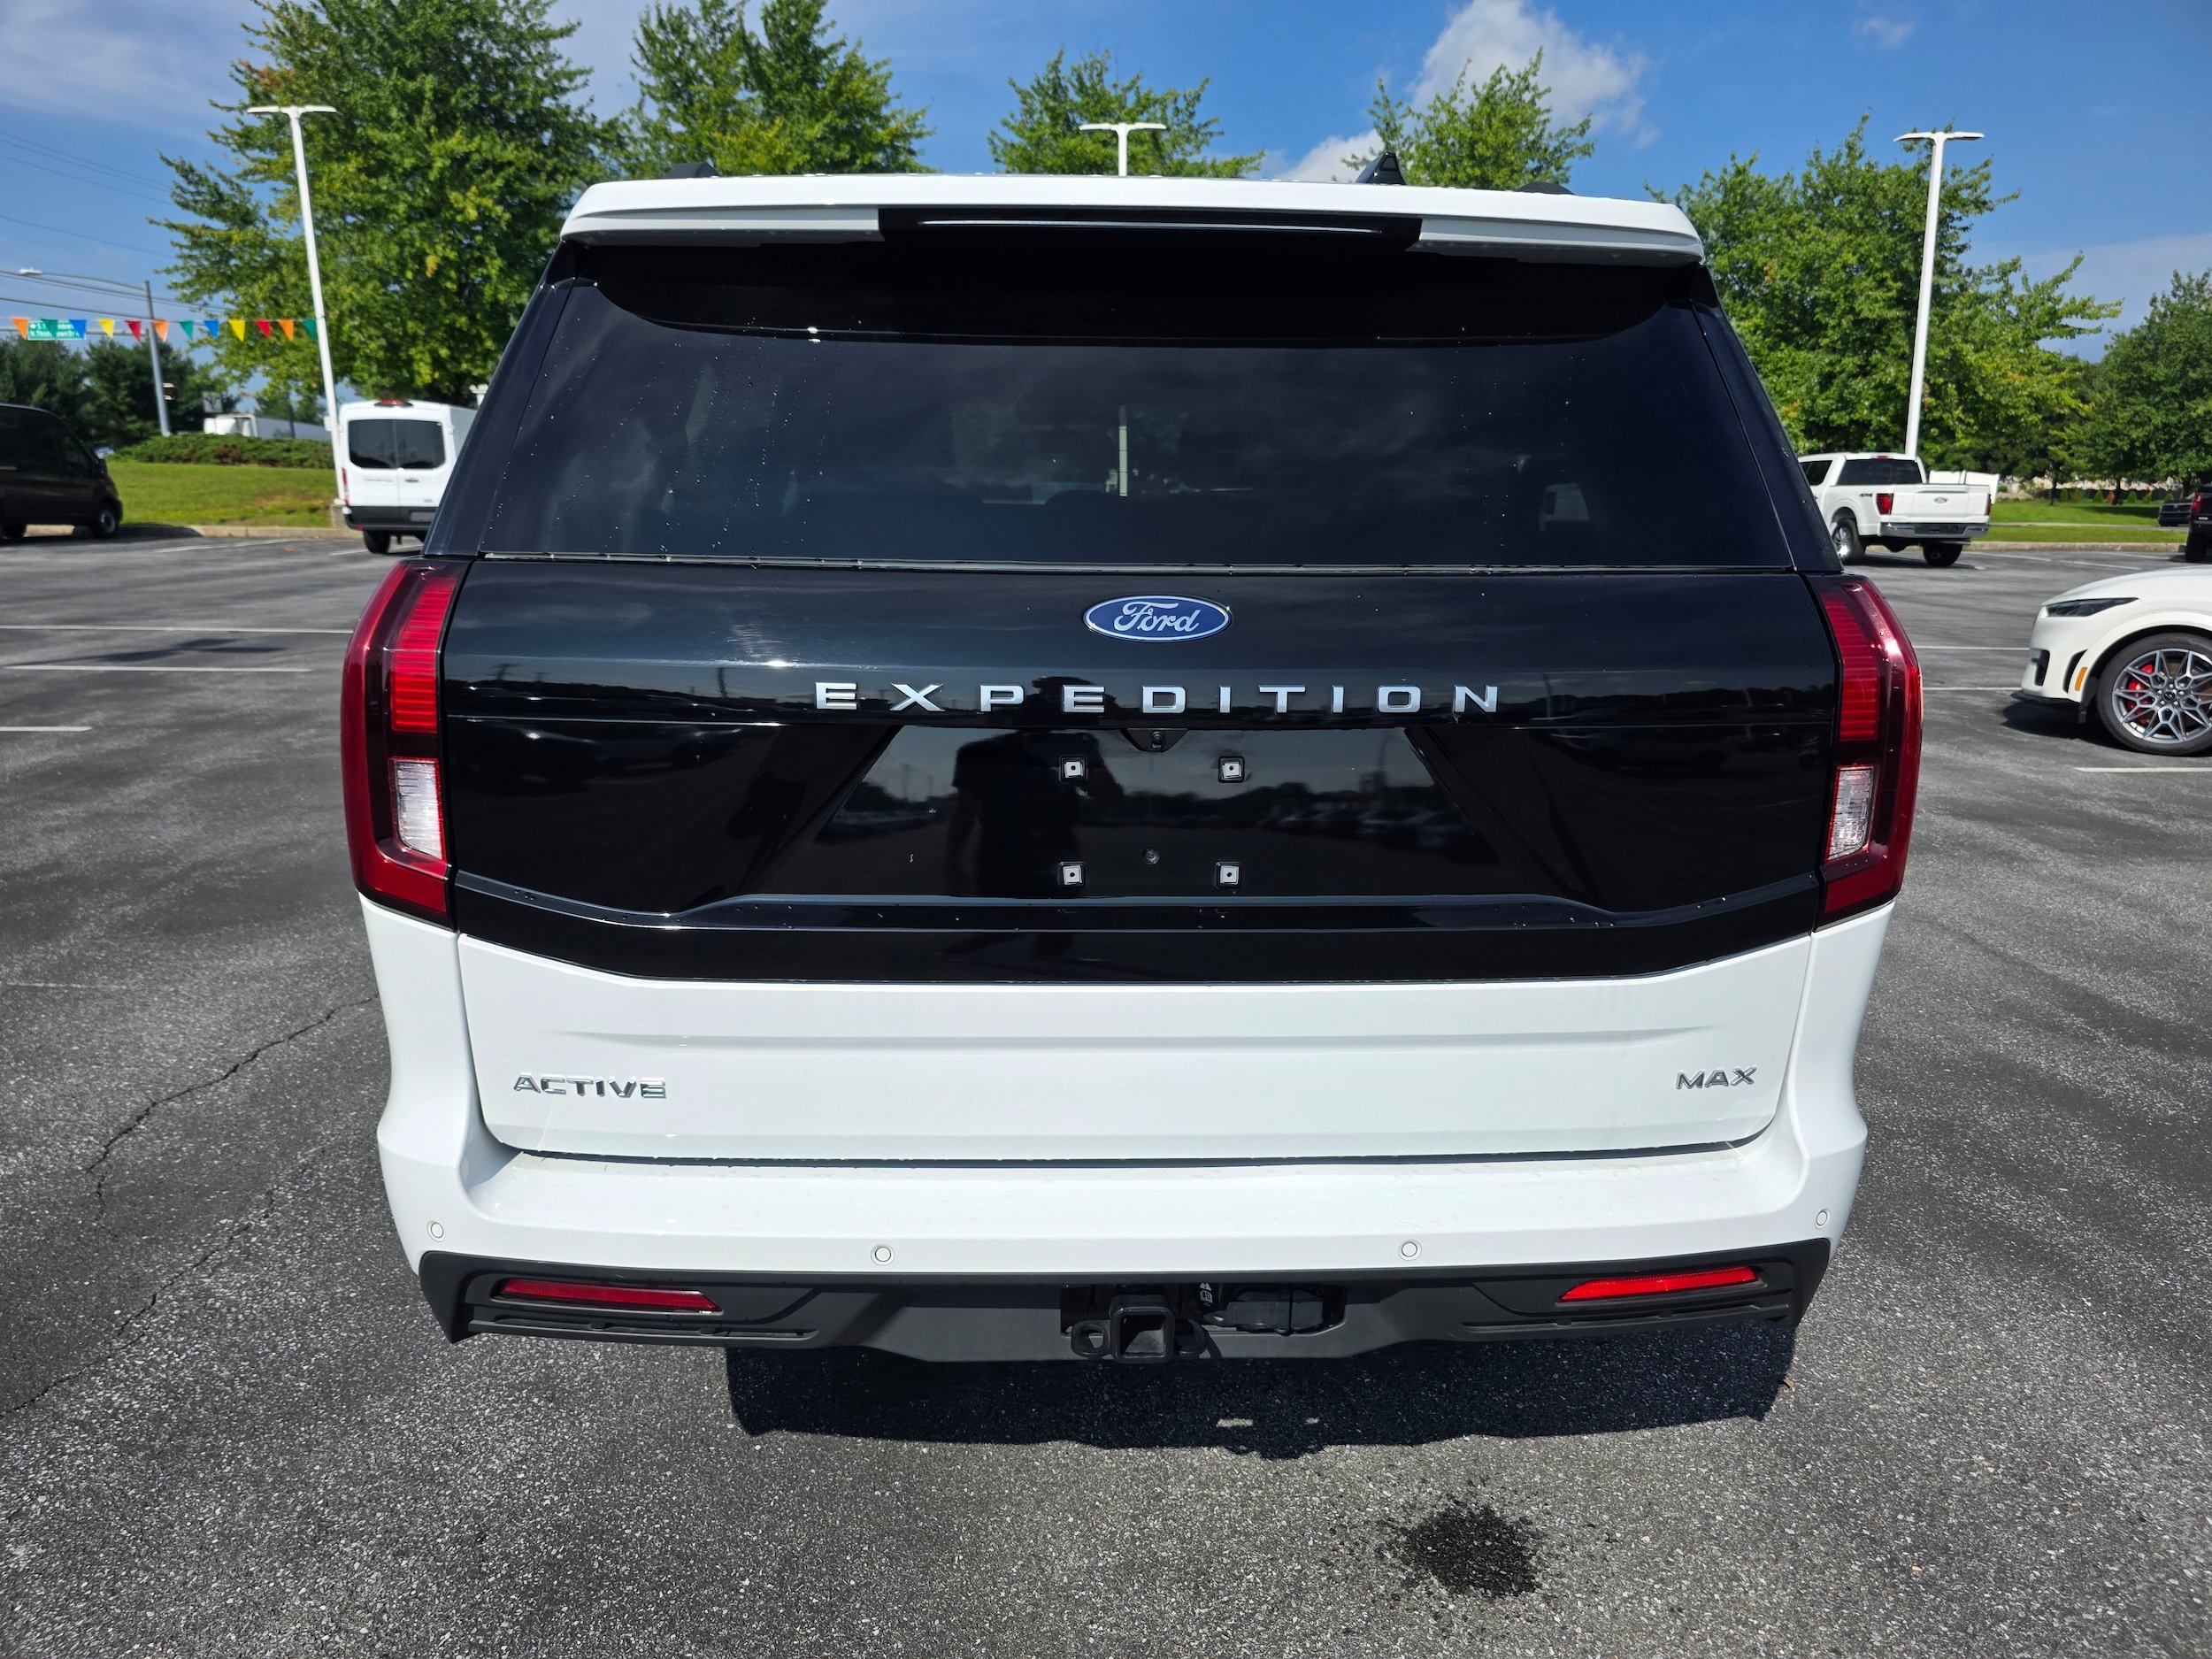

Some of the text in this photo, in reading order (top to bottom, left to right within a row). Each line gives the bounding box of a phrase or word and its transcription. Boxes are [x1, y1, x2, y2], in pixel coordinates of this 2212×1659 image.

[1113, 601, 1202, 633] Ford
[815, 681, 1499, 713] EXPEDITION
[513, 1071, 667, 1099] ACTIVE
[1675, 1065, 1757, 1090] MAX
